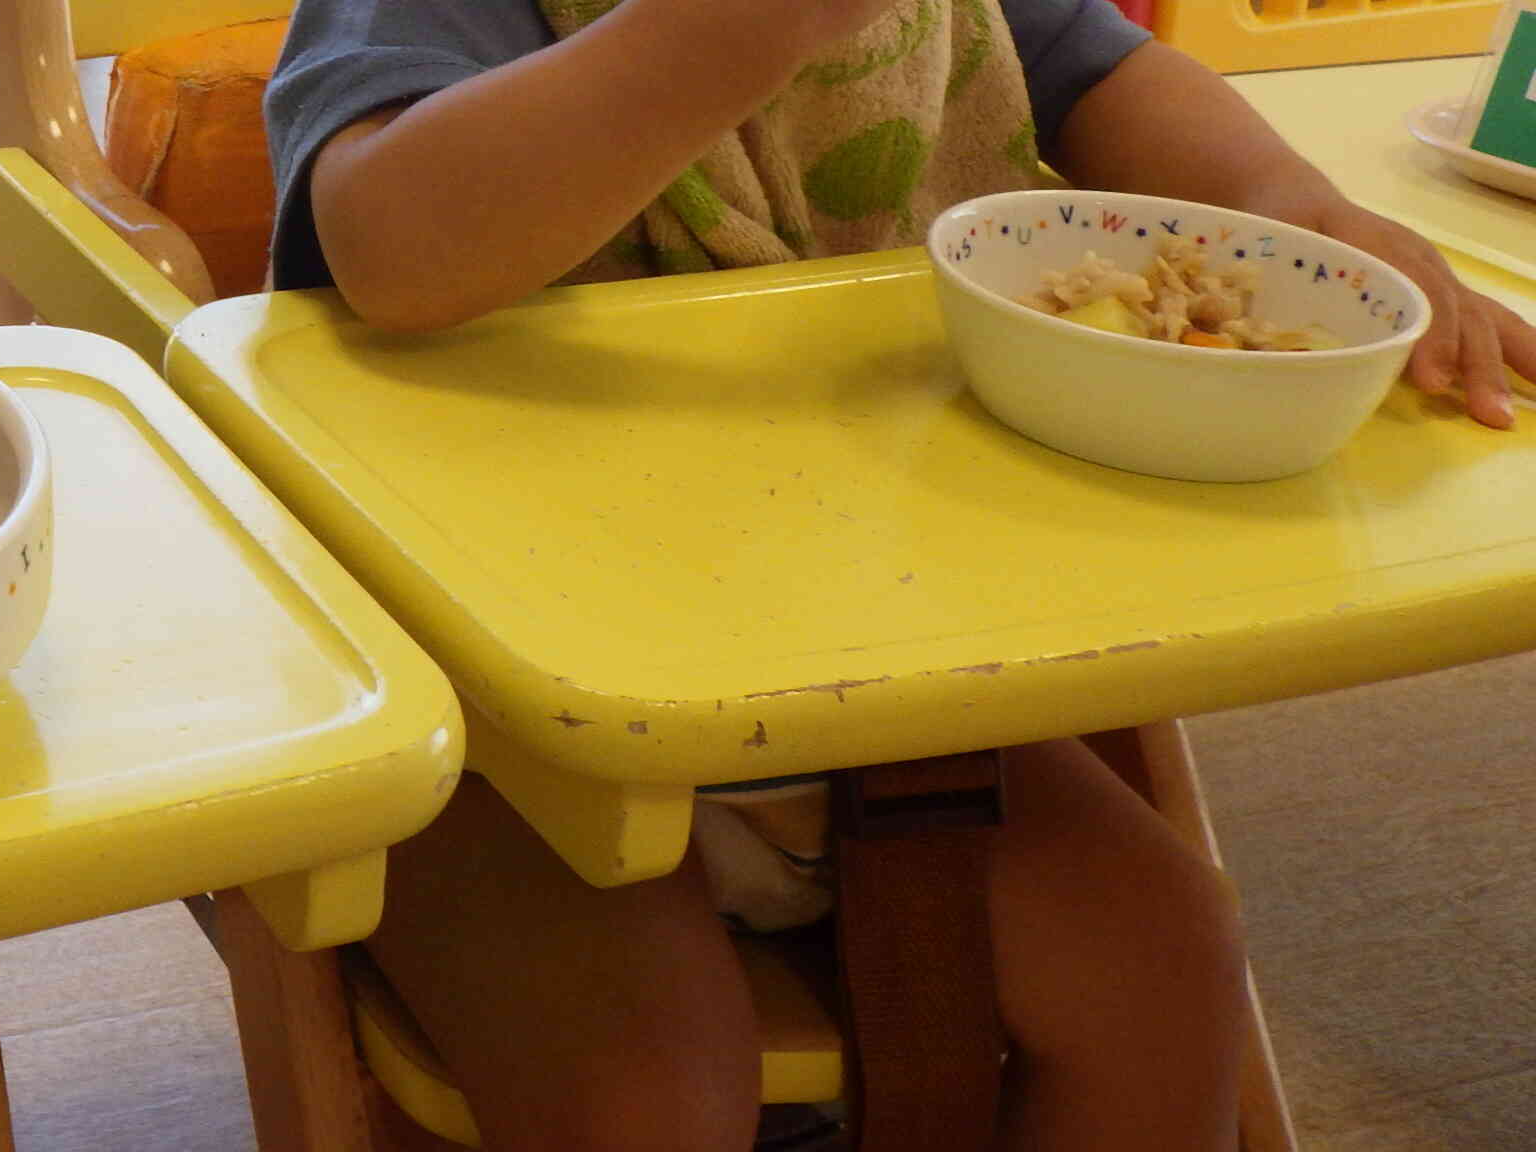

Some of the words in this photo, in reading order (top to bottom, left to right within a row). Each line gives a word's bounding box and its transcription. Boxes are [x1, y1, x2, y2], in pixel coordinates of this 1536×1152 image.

[1017, 225, 1032, 245] U
[1059, 205, 1074, 224] V
[1102, 208, 1128, 233] W
[1313, 263, 1329, 283] A
